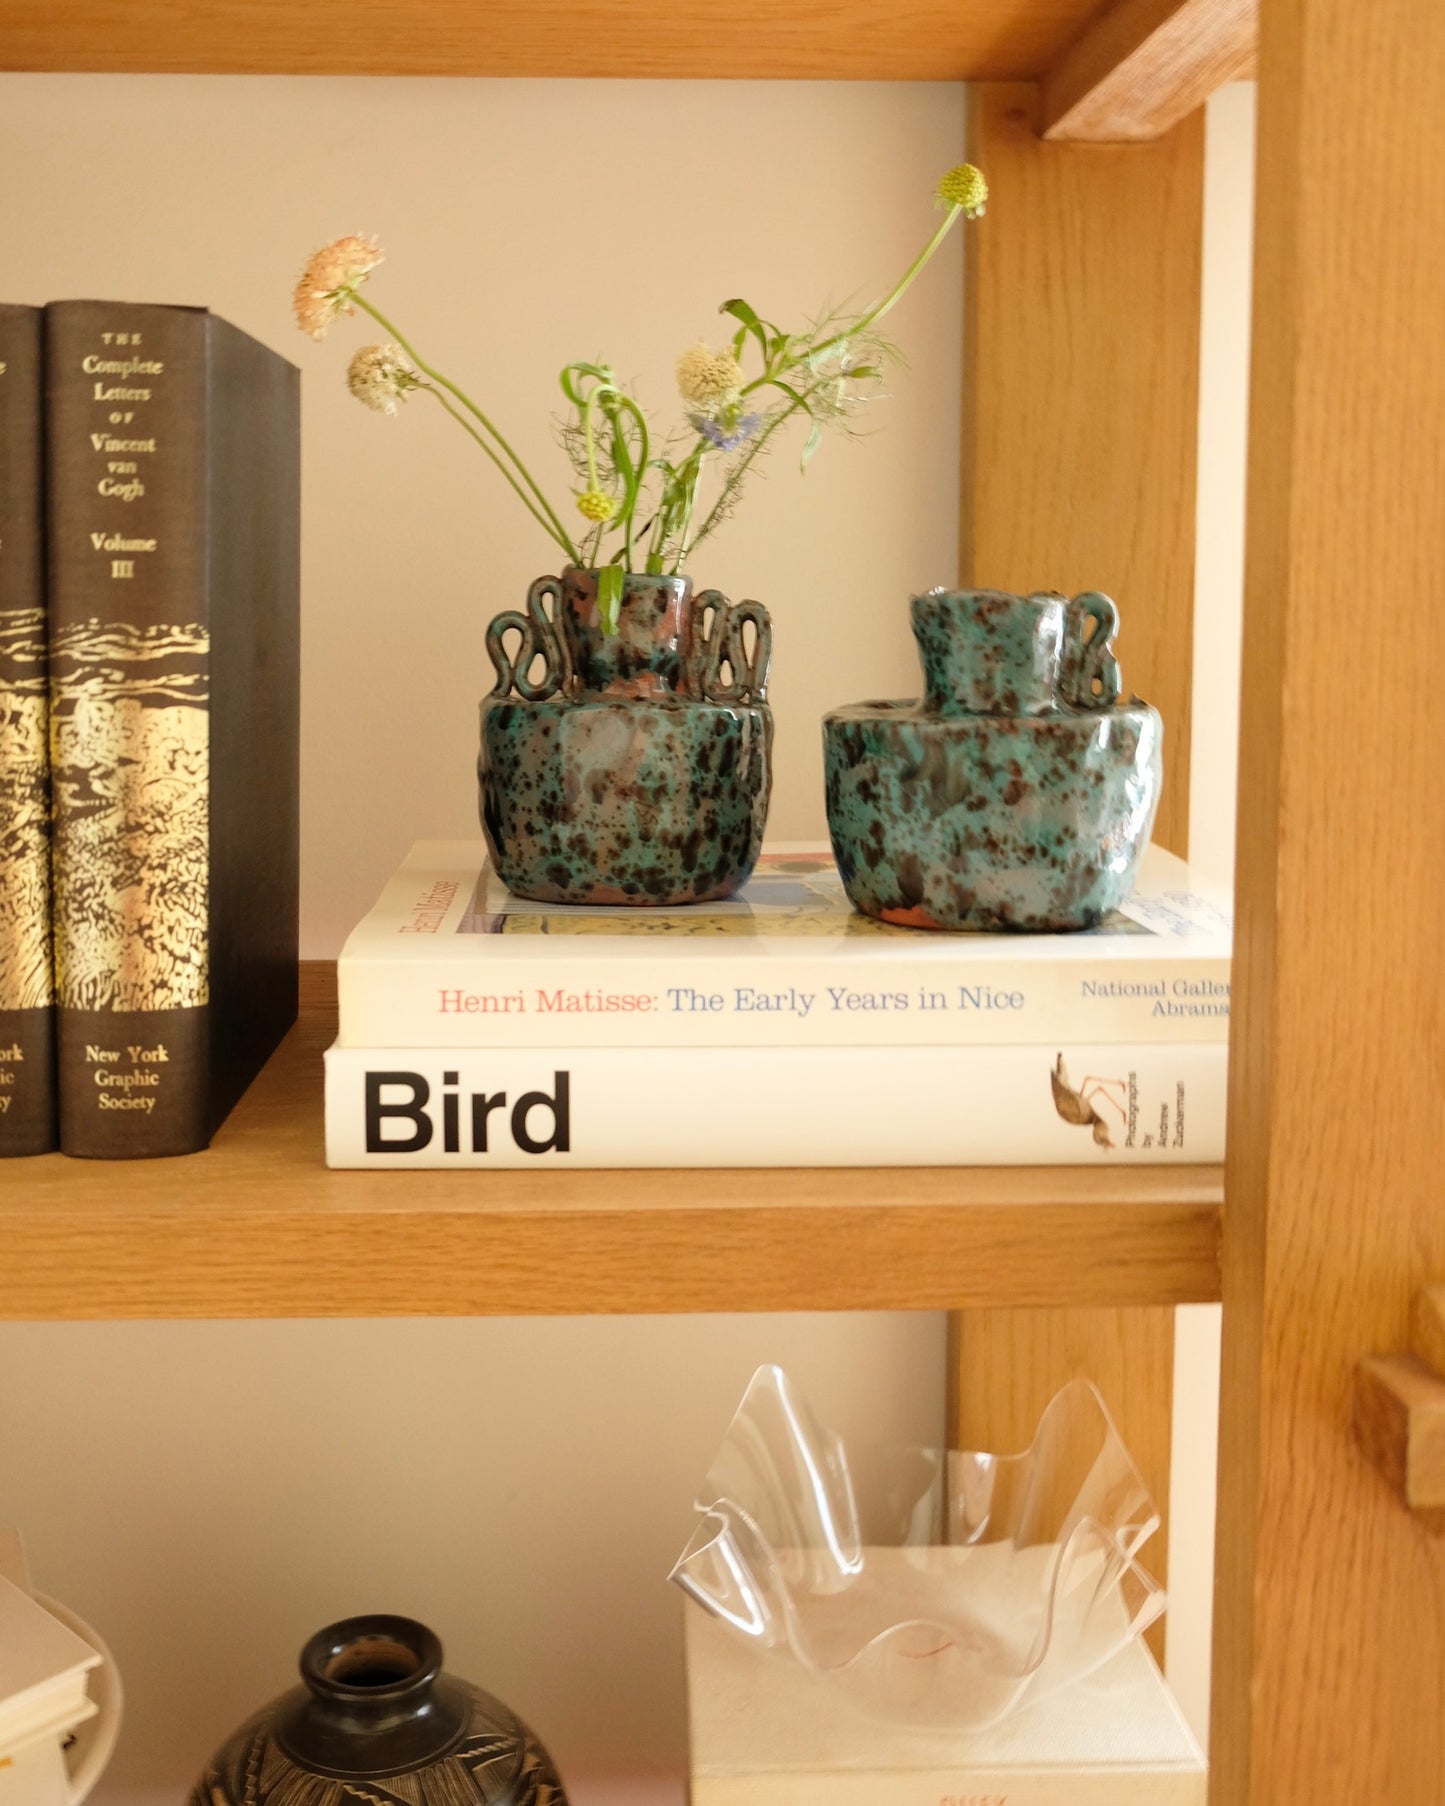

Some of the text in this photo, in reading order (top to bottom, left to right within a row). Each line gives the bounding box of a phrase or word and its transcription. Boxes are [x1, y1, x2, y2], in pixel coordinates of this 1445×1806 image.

[101, 332, 144, 345] THE
[82, 355, 165, 380] Complete
[94, 383, 152, 401] Letters
[109, 411, 134, 425] OF
[90, 433, 156, 453] Vincent
[107, 461, 138, 474] van
[97, 478, 145, 501] Gogh
[90, 532, 157, 552] Volume
[111, 559, 135, 579] III
[1081, 980, 1166, 997] National
[438, 985, 1025, 1018] Henri Matisse: The Early Years in Nice
[86, 1043, 169, 1063] New York
[94, 1069, 160, 1092] Graphic
[98, 1092, 156, 1114] Society
[364, 1070, 571, 1153] Bird
